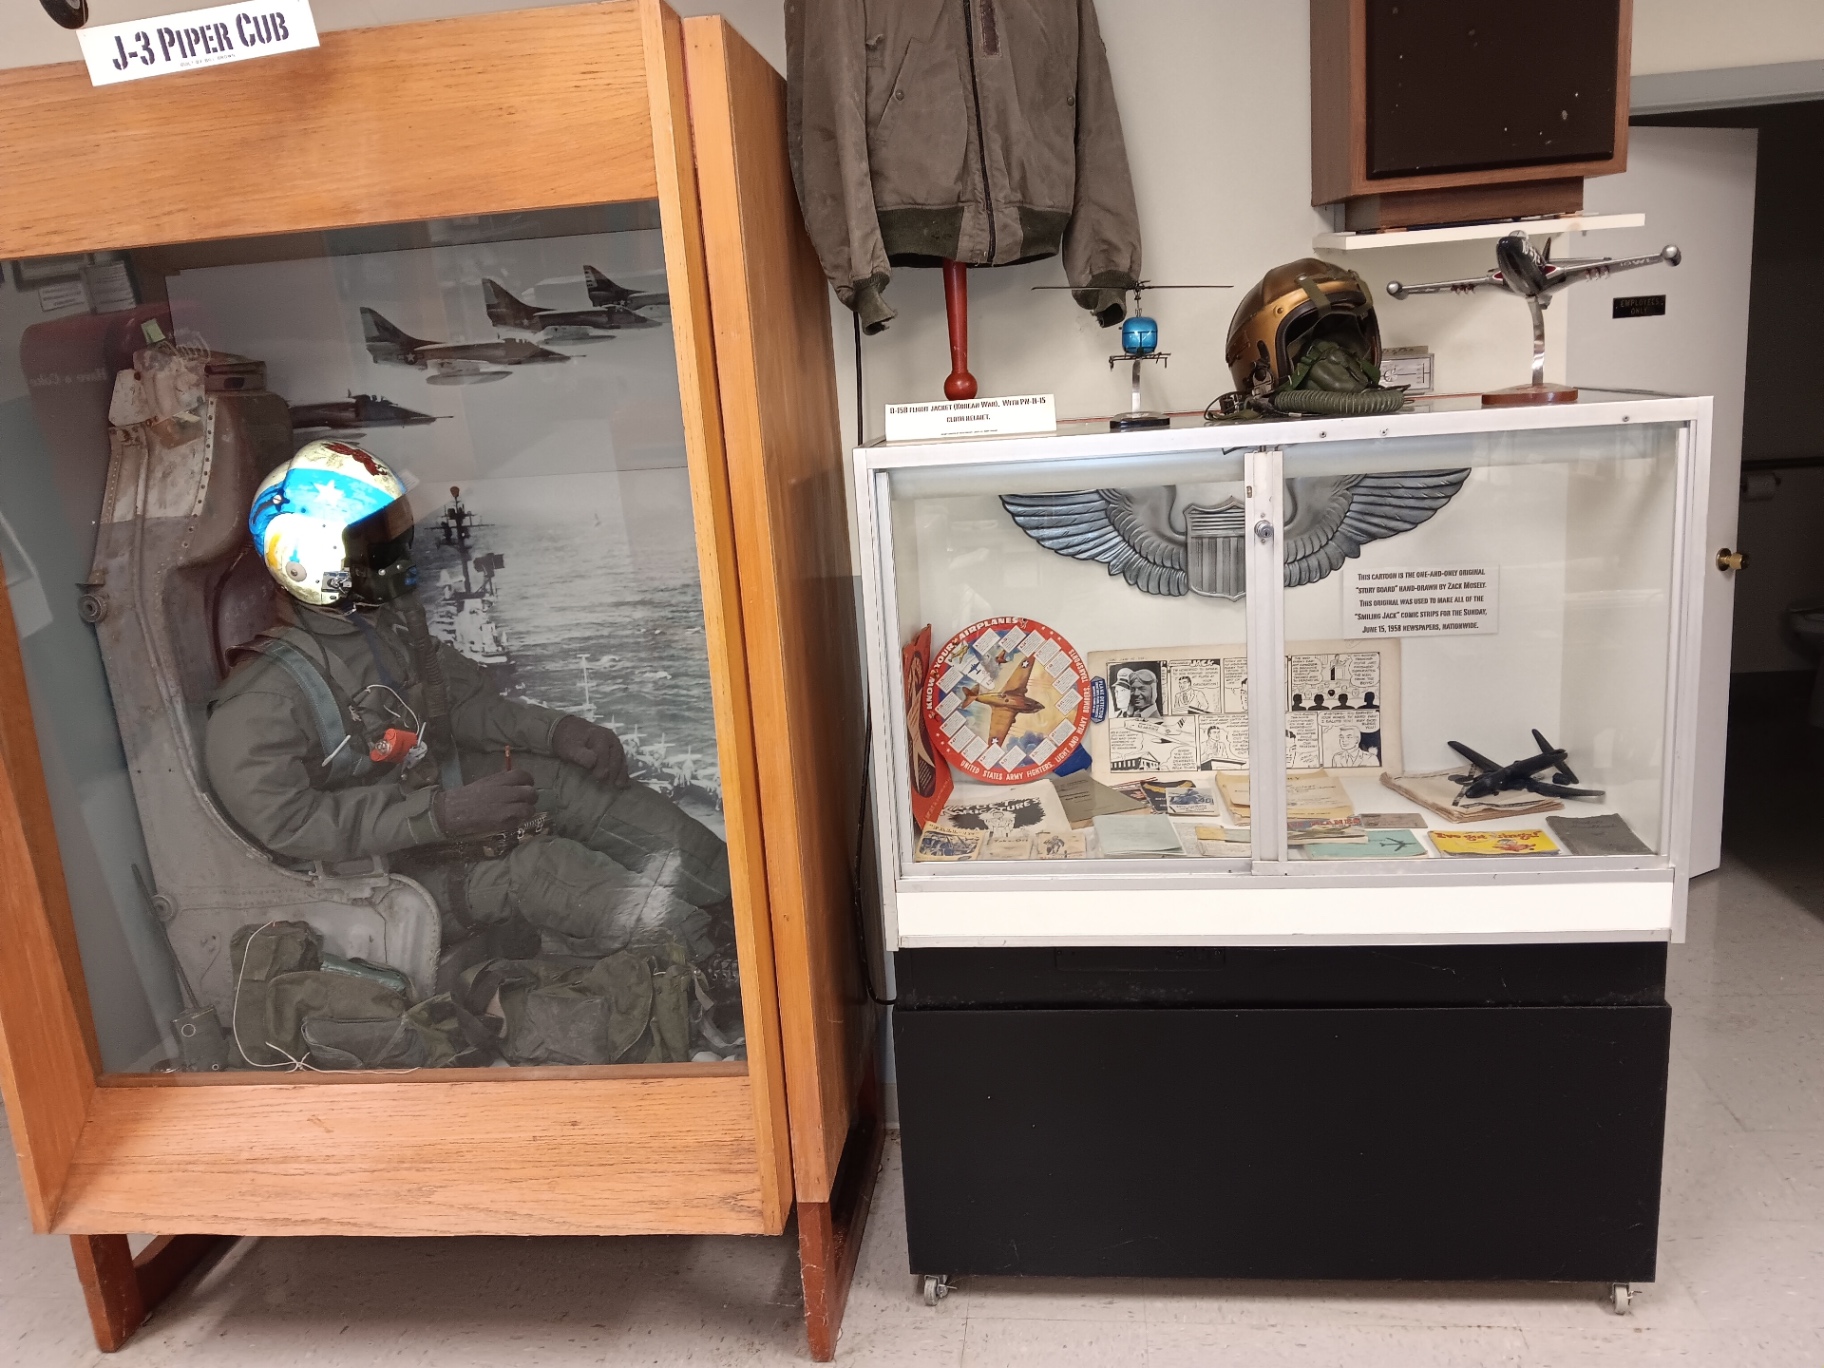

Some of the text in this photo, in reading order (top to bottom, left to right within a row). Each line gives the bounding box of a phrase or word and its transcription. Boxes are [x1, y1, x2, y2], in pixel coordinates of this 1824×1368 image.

[112, 12, 290, 71] J-3 PIPER CUB
[1620, 298, 1659, 307] EMPLOYEES
[1630, 307, 1648, 315] ONLY
[930, 404, 952, 412] JACKET
[1416, 570, 1458, 578] ONE-AND-ONLY
[1398, 584, 1438, 592] HAND-DRAWN
[926, 676, 937, 710] KNOW
[934, 643, 954, 669] YOUR
[958, 617, 1019, 640] AIRPLANES
[1068, 649, 1088, 683] TRANSPORTS
[1077, 716, 1088, 735] HEAVY
[1069, 736, 1080, 748] AND
[1054, 747, 1070, 763] LIGHT
[960, 760, 980, 774] UNITED
[982, 770, 1003, 780] STATES
[1006, 772, 1024, 781] ARMY
